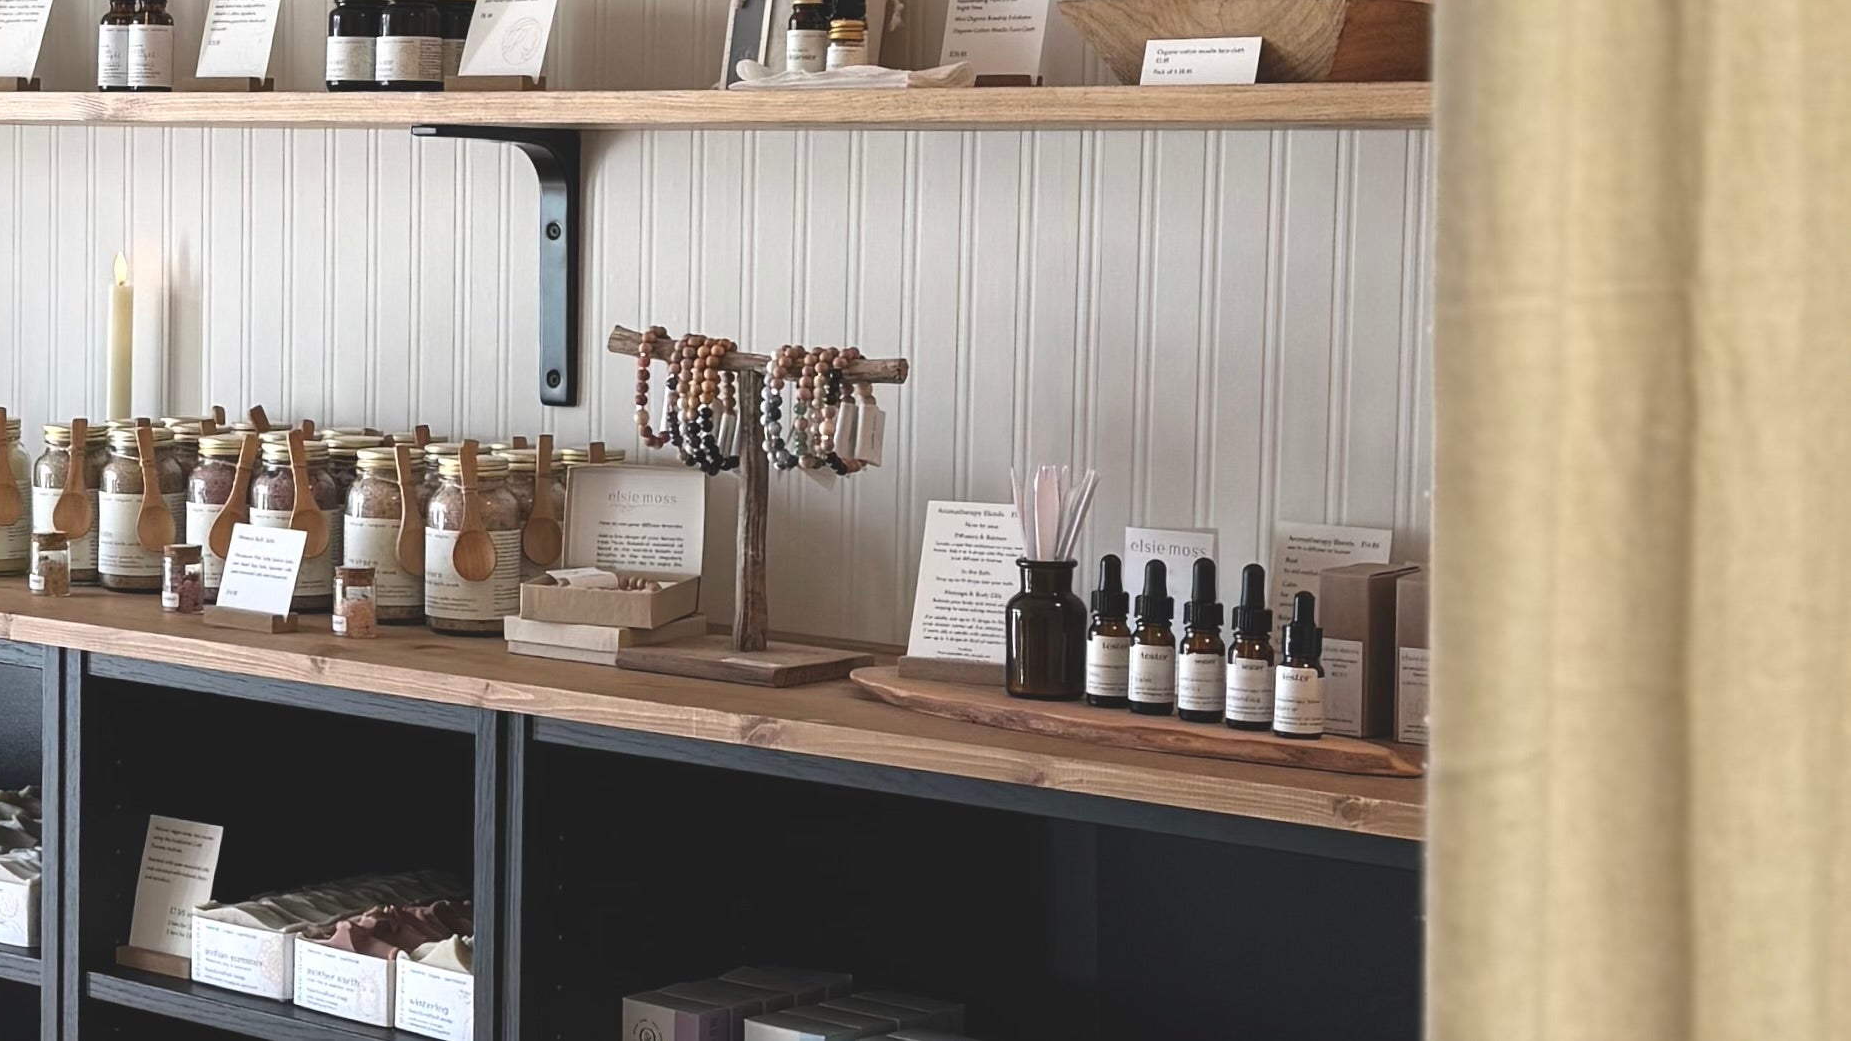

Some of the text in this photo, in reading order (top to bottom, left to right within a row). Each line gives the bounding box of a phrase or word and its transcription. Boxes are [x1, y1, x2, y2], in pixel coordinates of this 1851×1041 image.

[608, 490, 678, 504] elsie moss
[938, 507, 982, 517] Aromatherapy
[1130, 539, 1207, 558] elsie moss
[1140, 651, 1169, 661] tester
